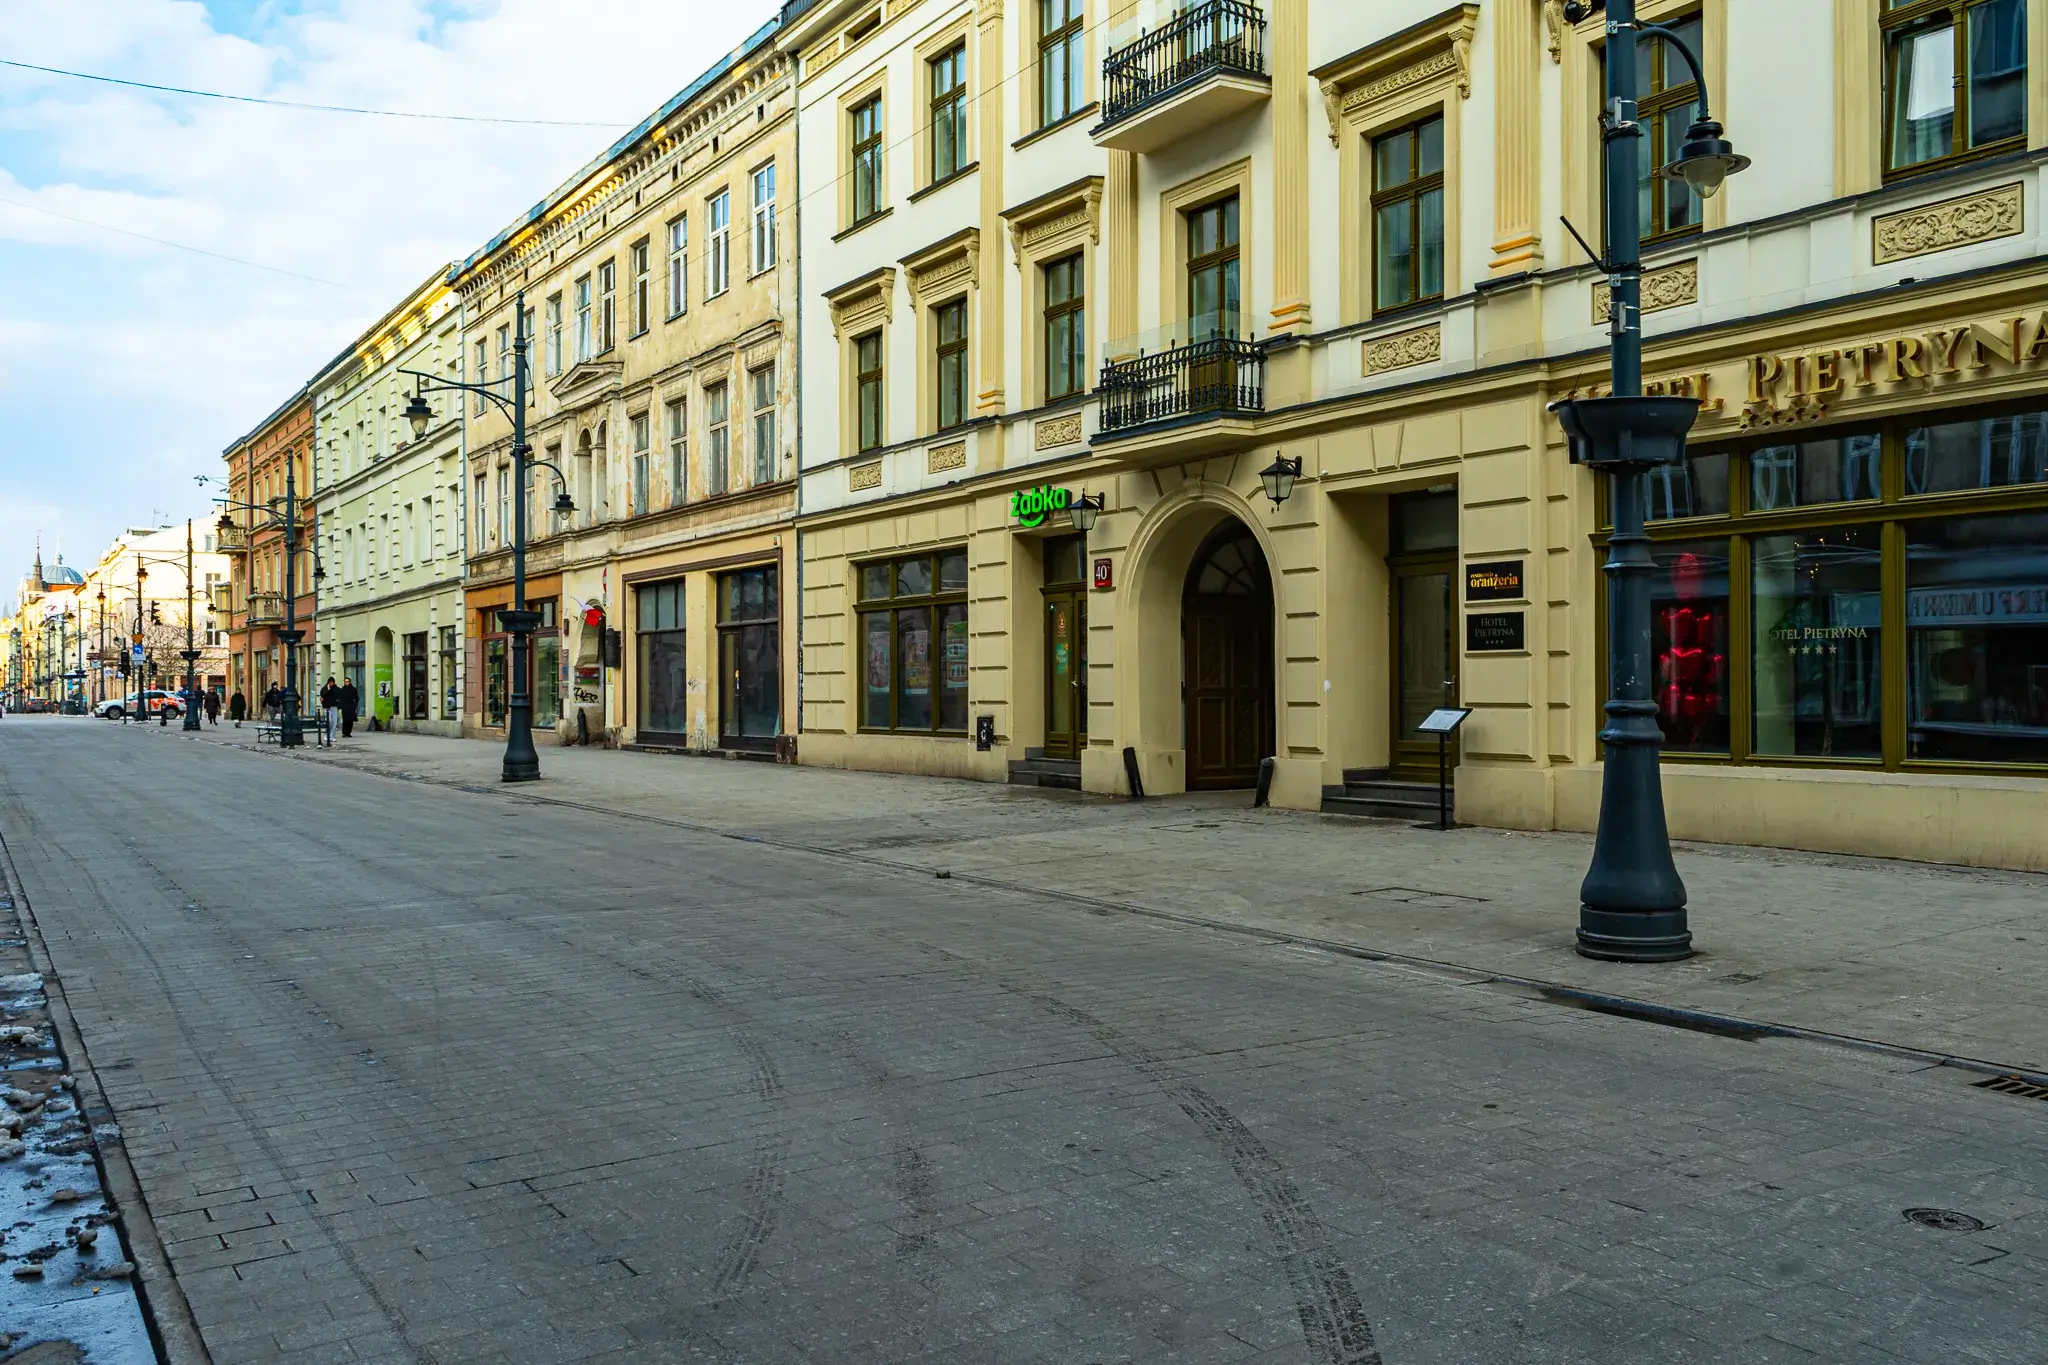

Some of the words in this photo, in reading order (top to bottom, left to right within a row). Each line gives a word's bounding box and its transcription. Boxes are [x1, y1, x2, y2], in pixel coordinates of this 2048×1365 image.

[1011, 484, 1067, 517] żabka
[1096, 565, 1108, 580] 40
[1470, 572, 1519, 588] oranżeria
[1481, 617, 1508, 627] HOTEL
[1475, 627, 1515, 637] PIETRYNA
[1765, 629, 1801, 640] OTEL
[1804, 627, 1868, 639] PIETRYNA
